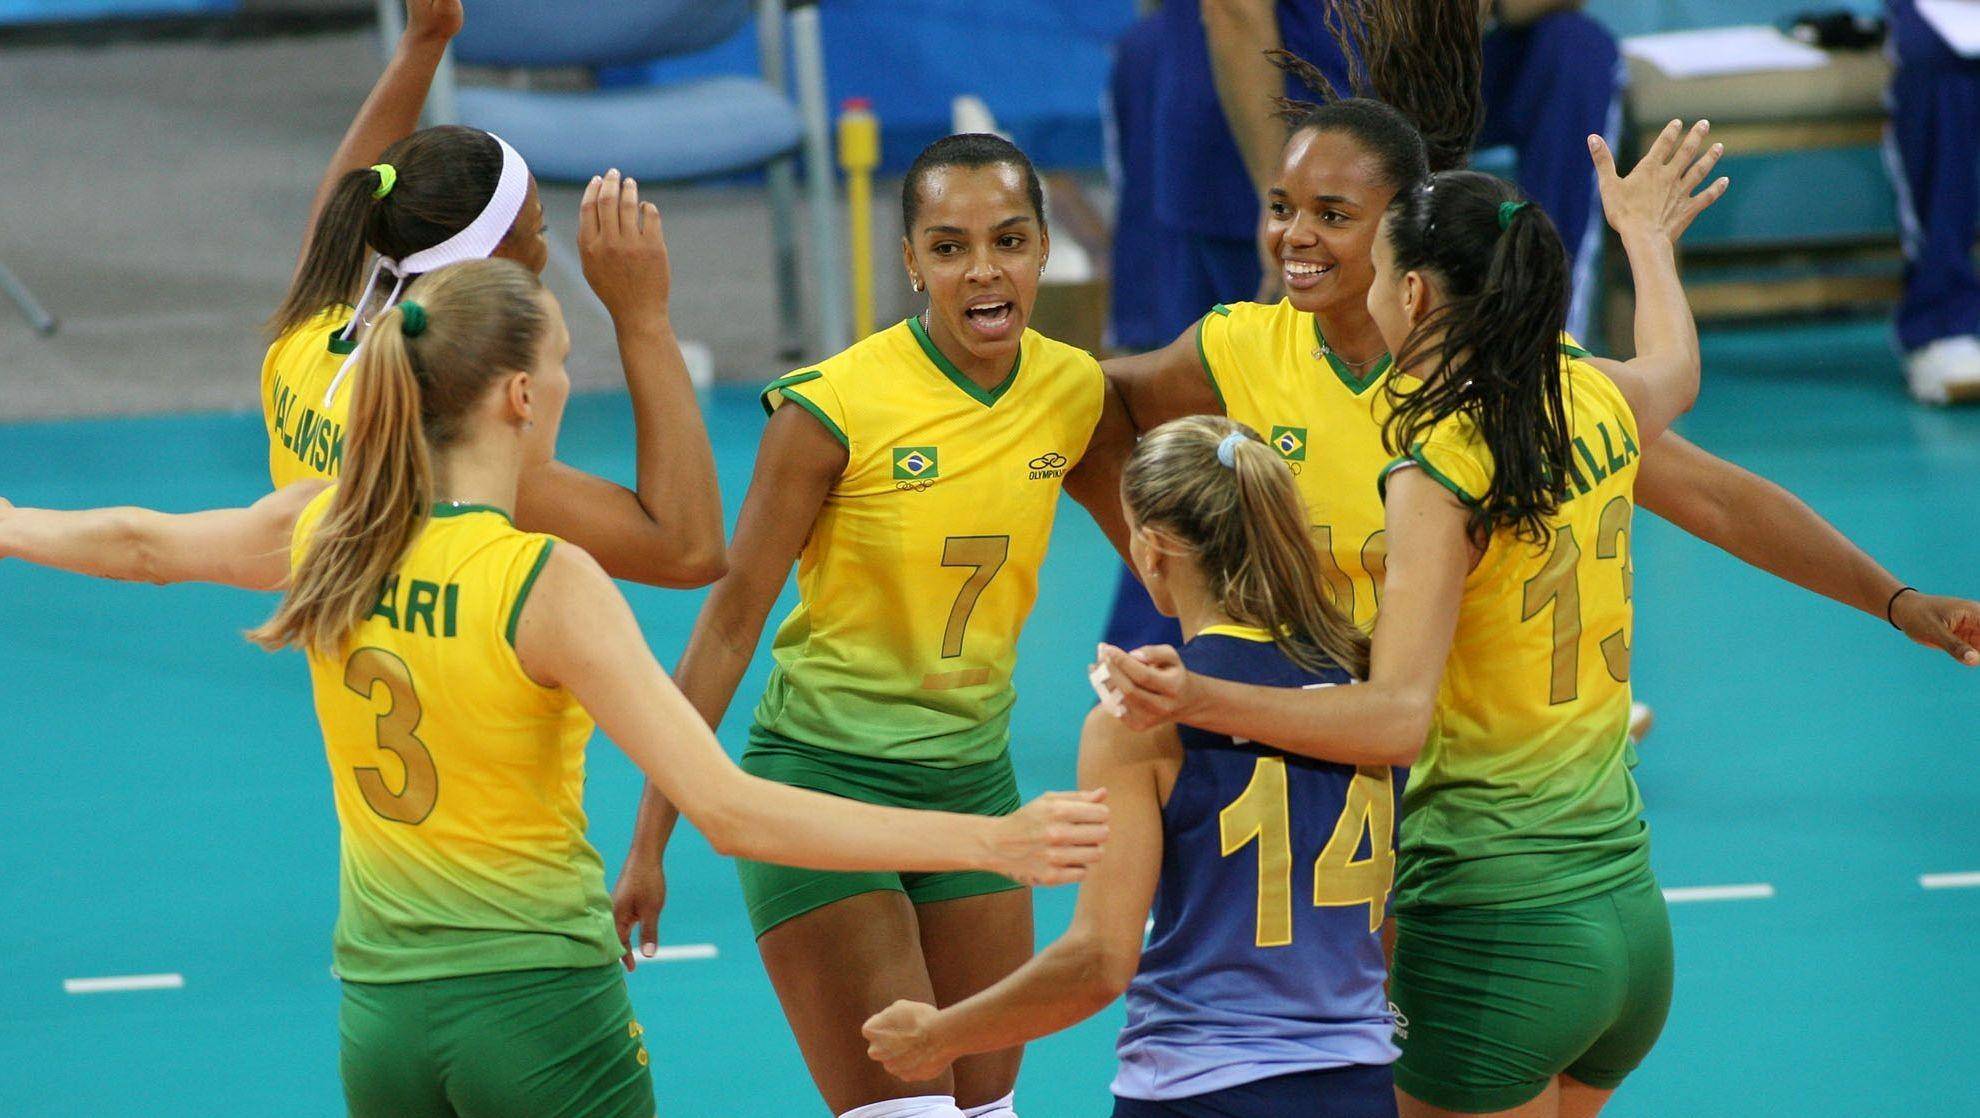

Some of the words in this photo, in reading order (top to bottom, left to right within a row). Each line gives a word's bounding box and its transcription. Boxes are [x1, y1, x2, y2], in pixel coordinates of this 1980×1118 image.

[362, 574, 459, 638] ARI
[941, 535, 1010, 659] 7
[1521, 494, 1632, 705] 13
[344, 646, 439, 826] 3
[1219, 756, 1396, 947] 14
